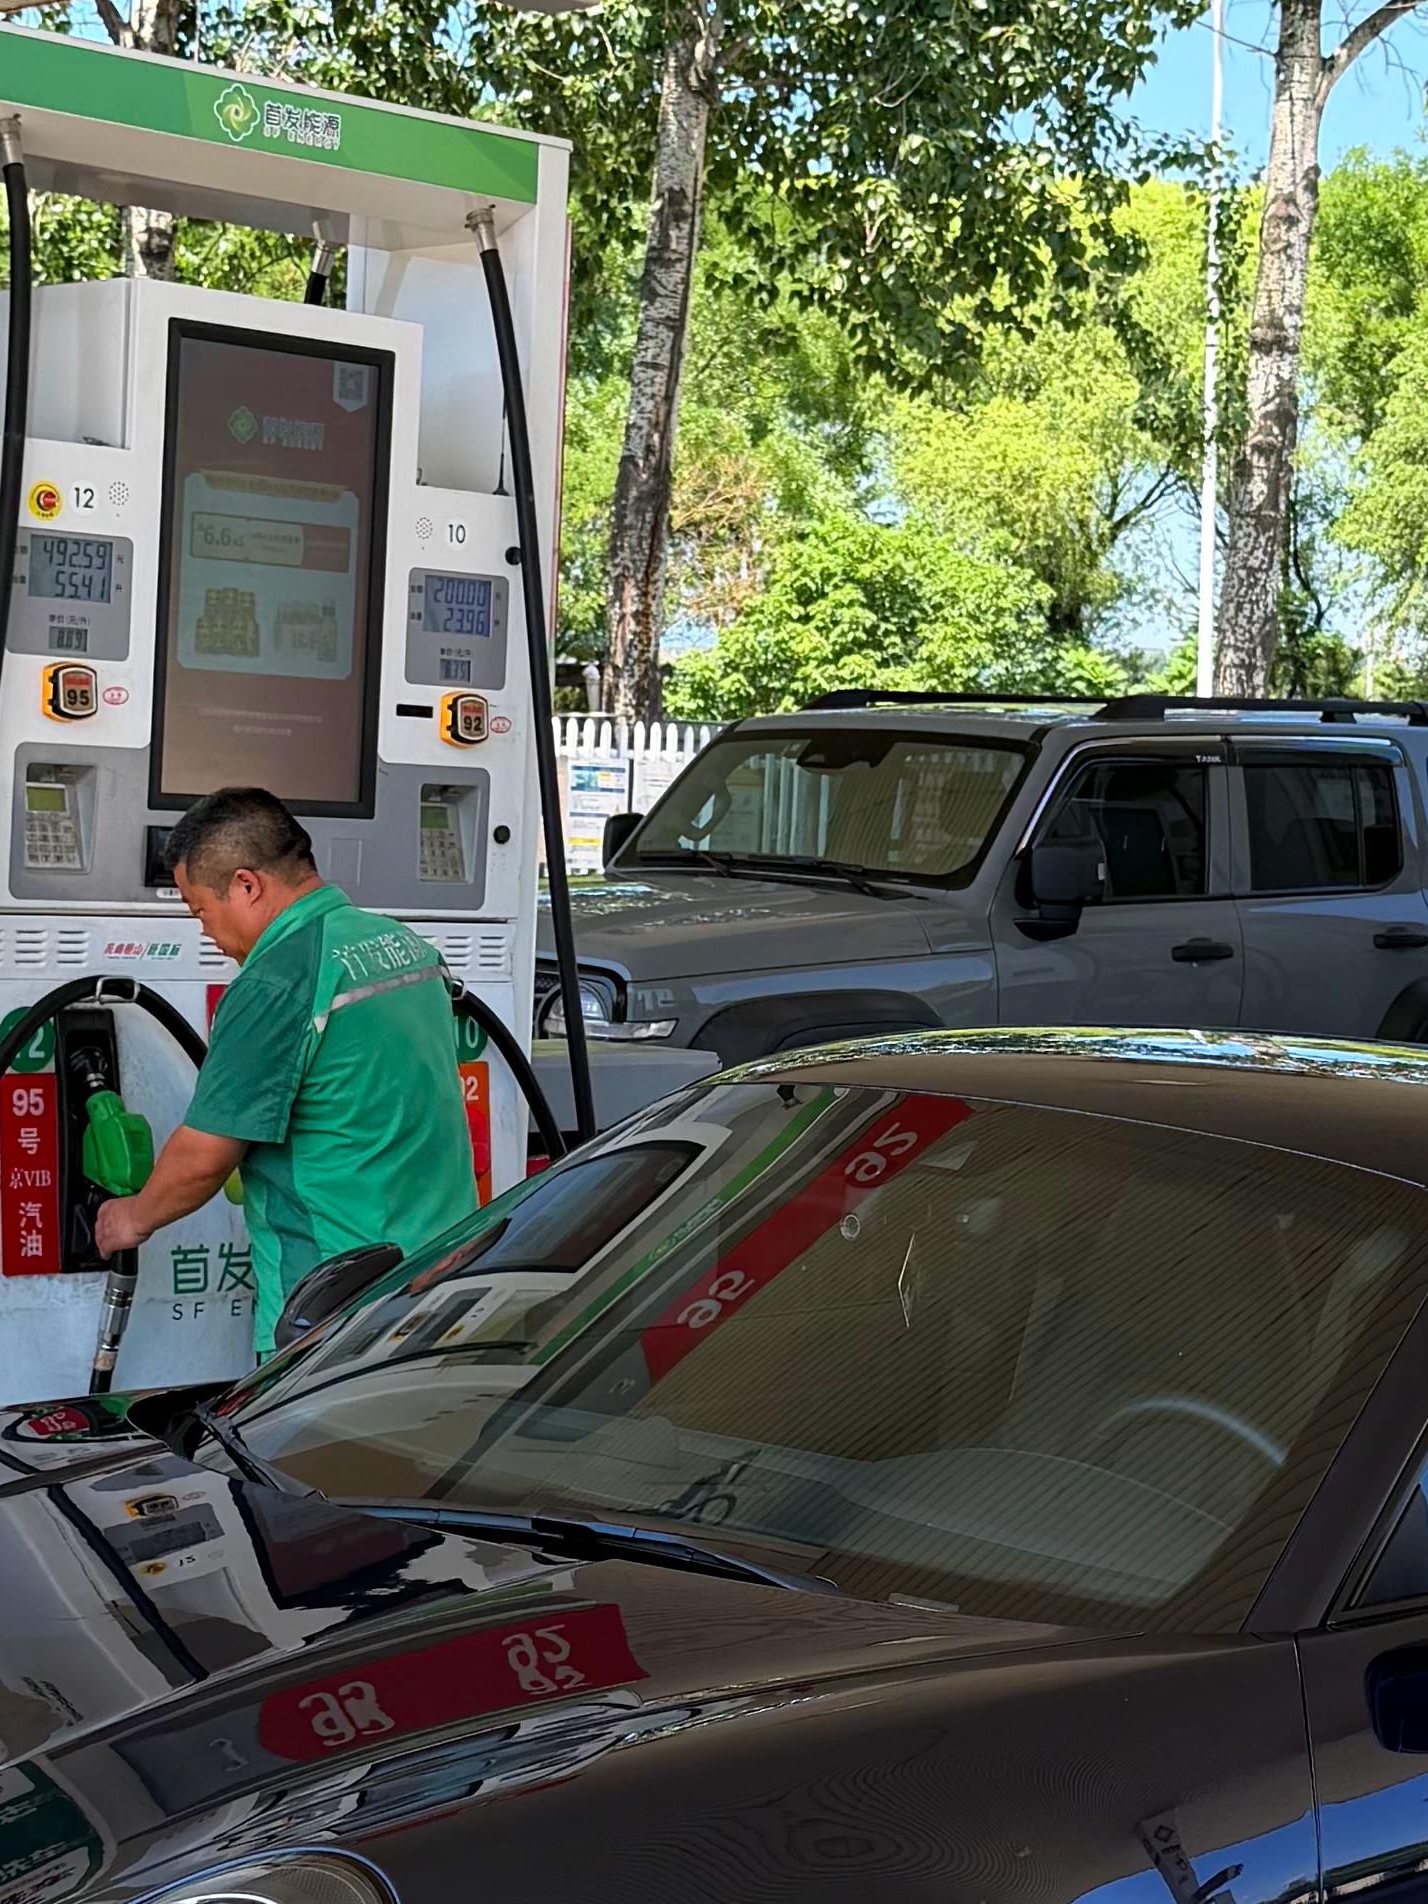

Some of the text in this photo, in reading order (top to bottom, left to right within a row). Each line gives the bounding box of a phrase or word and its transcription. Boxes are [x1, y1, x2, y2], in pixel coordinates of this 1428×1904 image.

[264, 100, 341, 138] 首发能源
[74, 487, 95, 509] 12
[448, 523, 467, 544] 10
[66, 688, 90, 706] 95
[463, 715, 483, 732] 92
[12, 1088, 45, 1117] 95
[18, 1127, 41, 1155] 号
[20, 1201, 44, 1258] 汽油
[172, 1302, 205, 1321] SF
